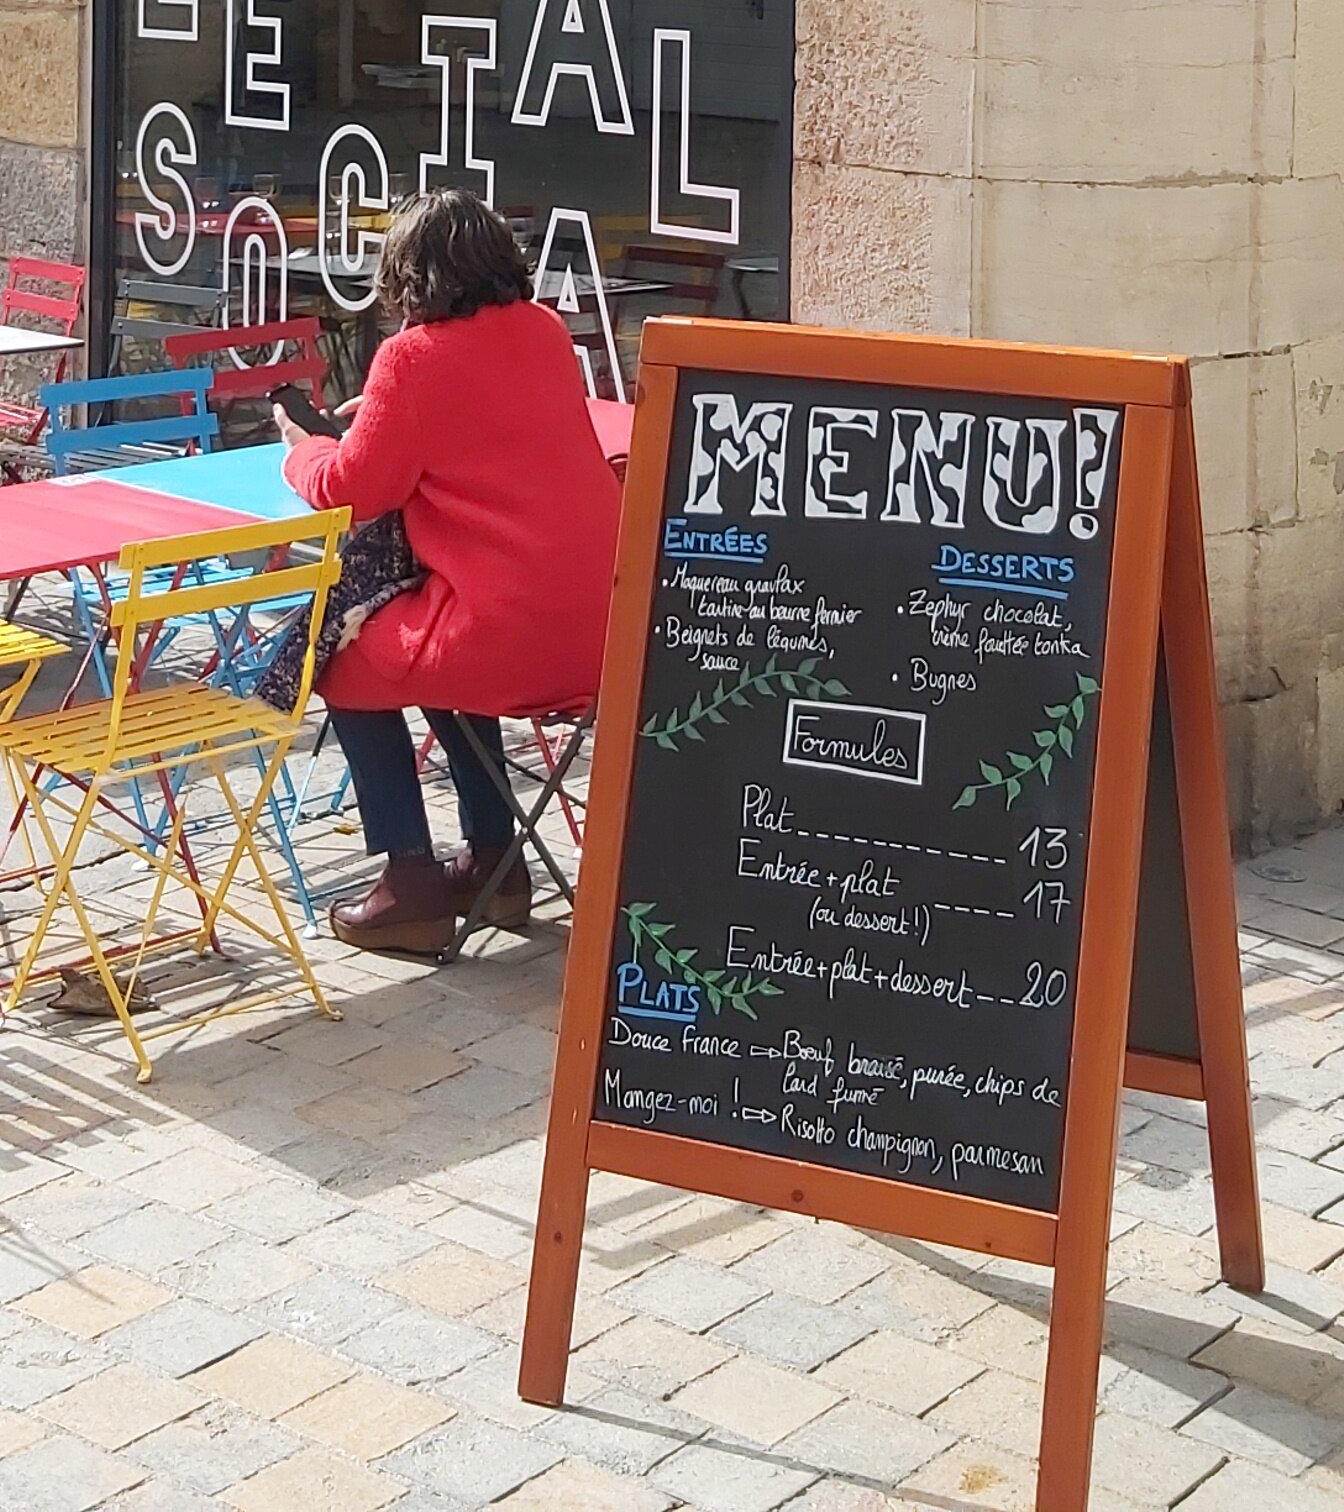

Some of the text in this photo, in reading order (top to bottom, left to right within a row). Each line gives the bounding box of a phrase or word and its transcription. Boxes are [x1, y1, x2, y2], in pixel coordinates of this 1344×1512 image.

[683, 392, 1119, 540] MENU!
[931, 544, 1076, 583] DESSERTS
[666, 615, 729, 662] Beignets
[736, 624, 756, 647] de
[699, 652, 741, 671] sauce
[1034, 630, 1092, 659] tonka
[910, 657, 977, 706] Bugnes
[793, 714, 909, 771] Formules
[742, 783, 1069, 870] Plat 13
[1022, 879, 1072, 924] 17
[616, 962, 701, 1013] PLATS
[1019, 961, 1068, 1008] 20
[608, 1016, 673, 1052] Douce
[974, 1066, 1026, 1107] chips
[1031, 1077, 1062, 1109] de
[780, 1102, 836, 1145] Risotto
[951, 1141, 1046, 1182] parmesan
